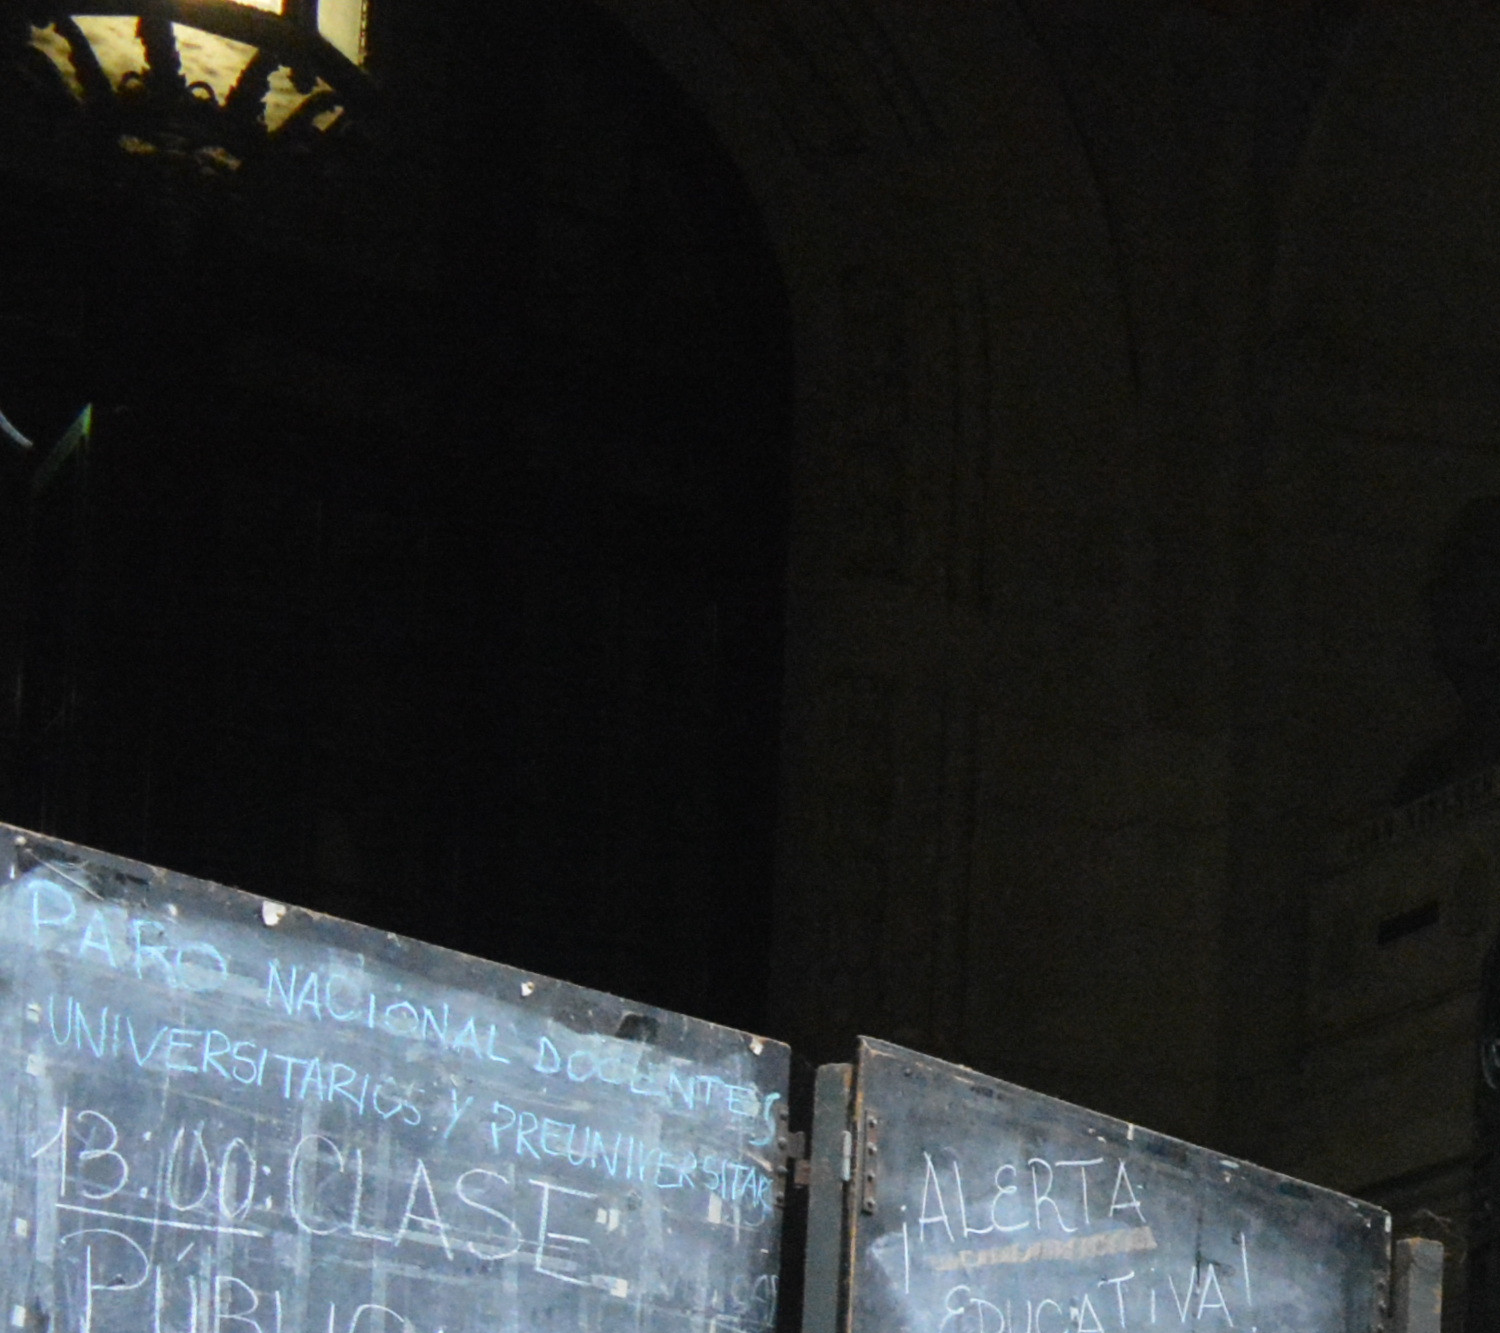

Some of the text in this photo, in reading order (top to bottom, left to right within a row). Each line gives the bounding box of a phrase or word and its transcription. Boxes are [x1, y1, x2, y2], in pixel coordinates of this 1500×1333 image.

[30, 880, 781, 1146] PARO NACIONAL DOCENTES
[290, 1134, 600, 1285] CLASE
